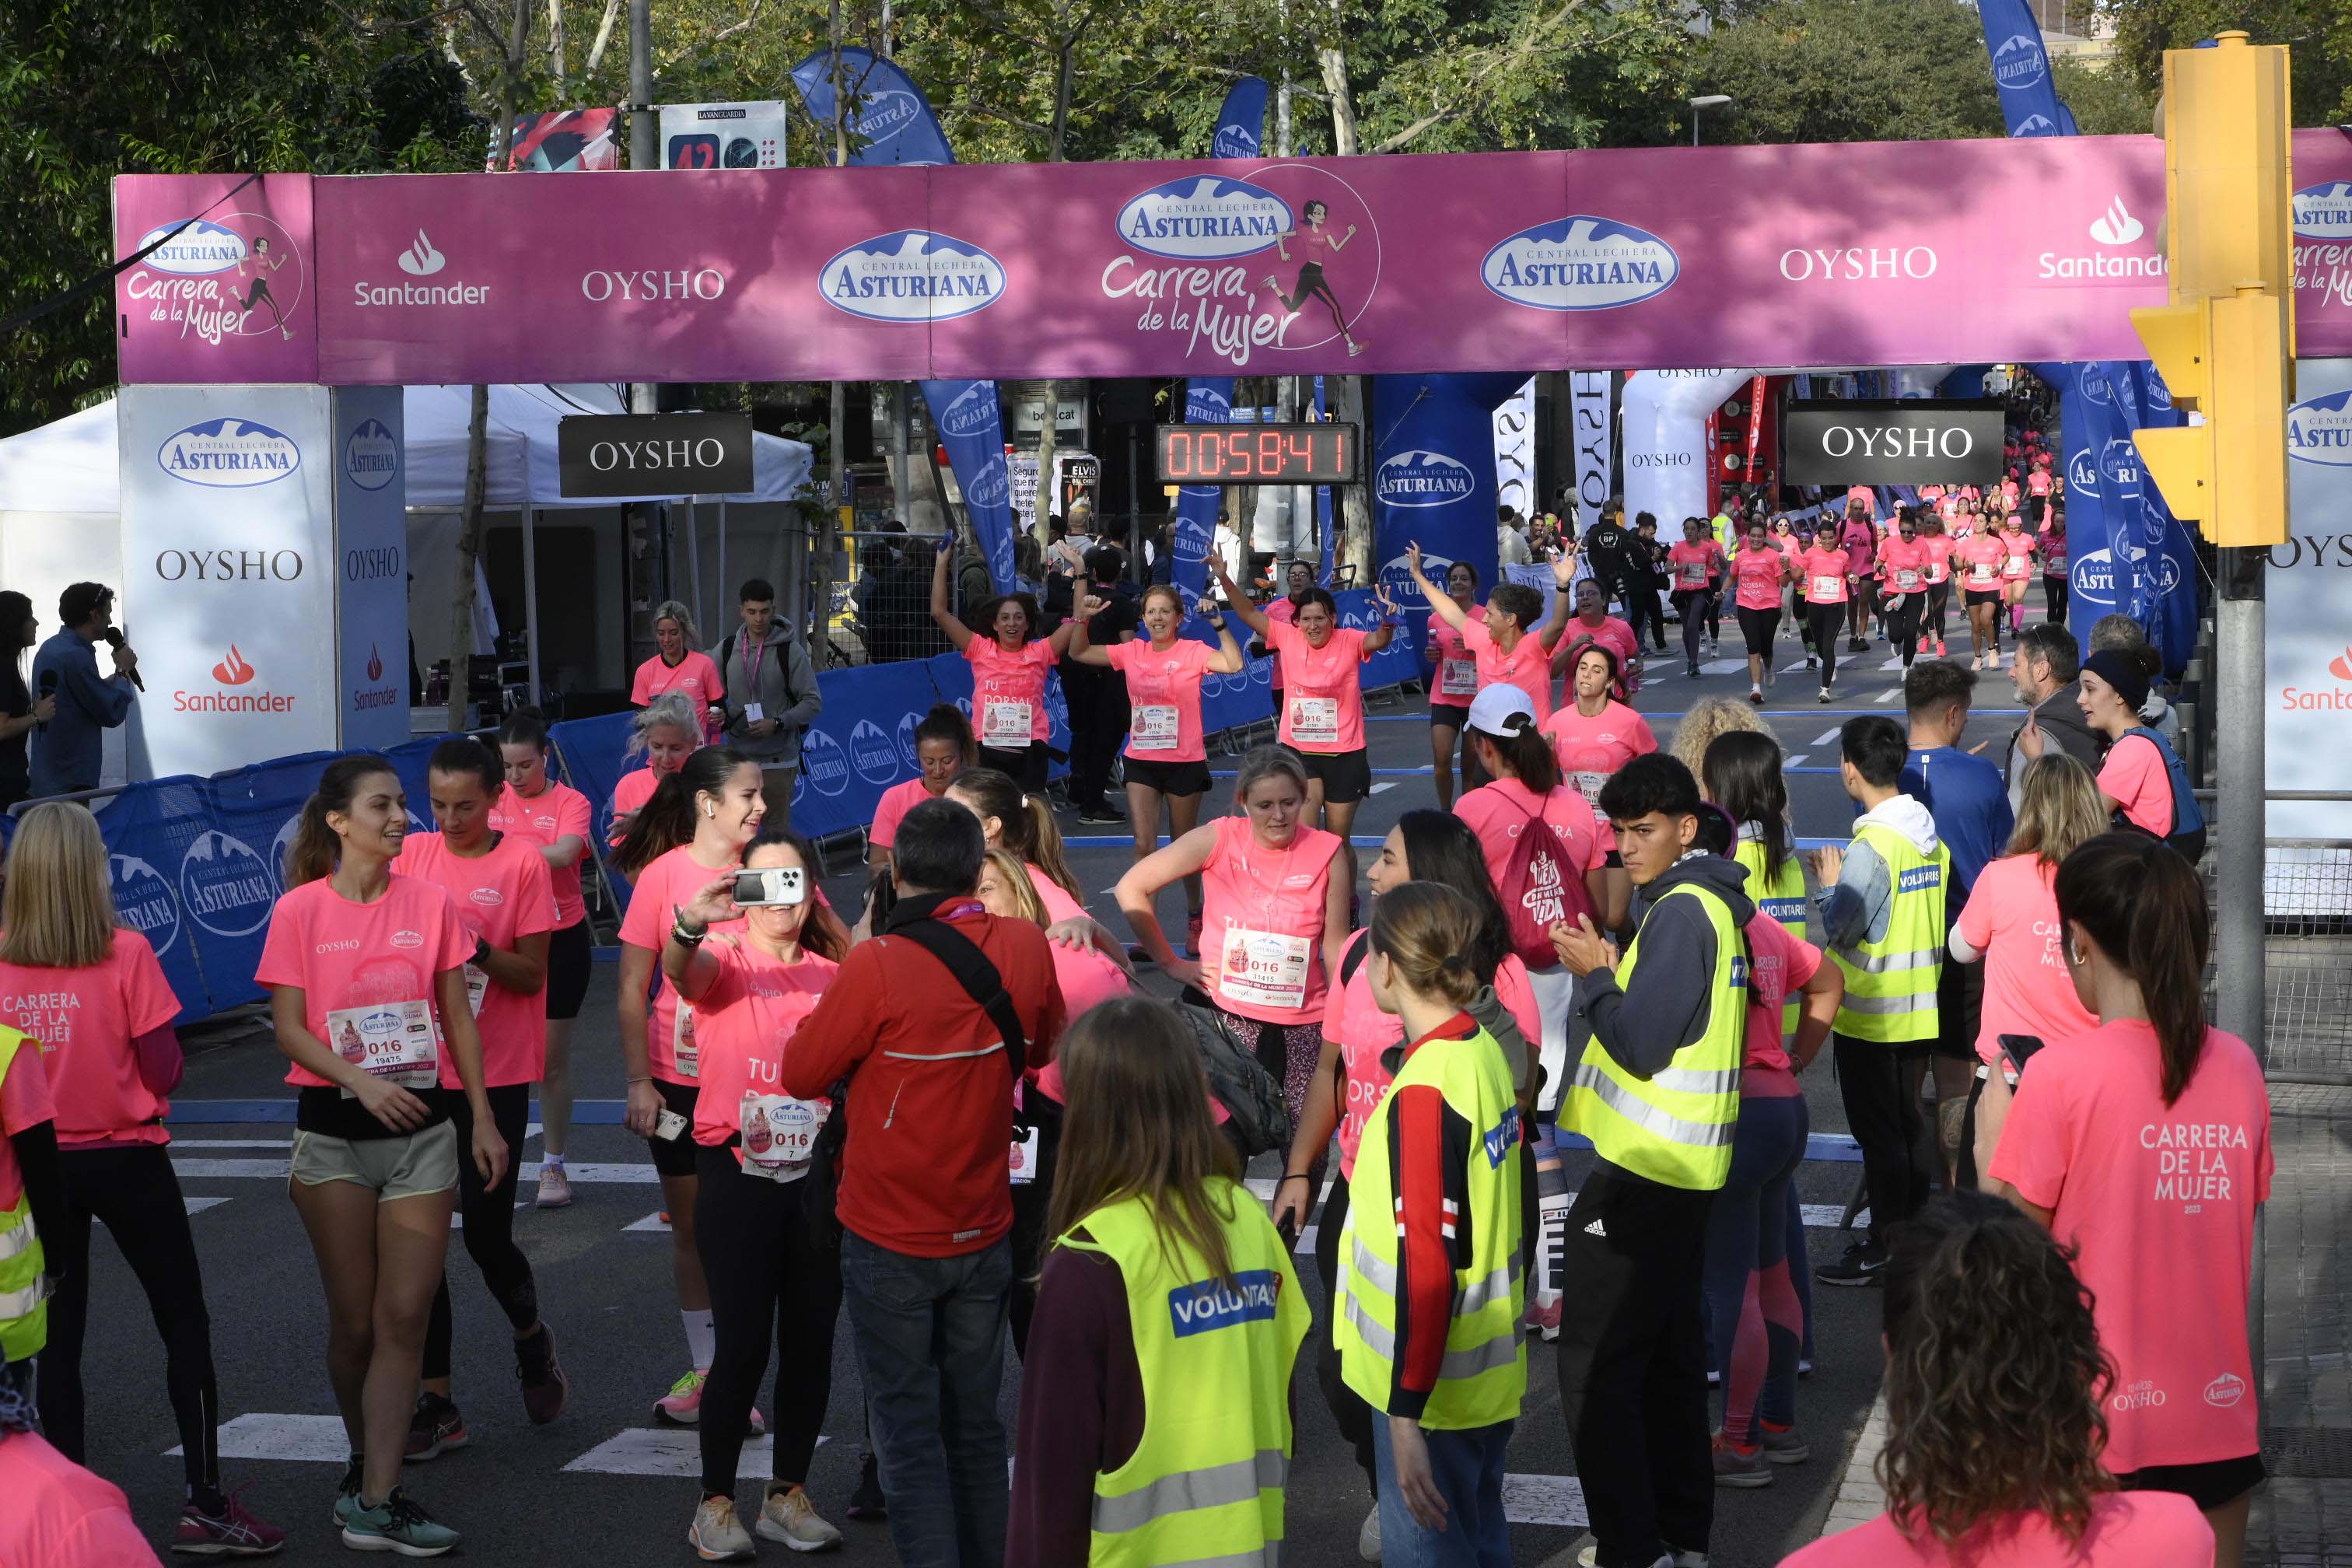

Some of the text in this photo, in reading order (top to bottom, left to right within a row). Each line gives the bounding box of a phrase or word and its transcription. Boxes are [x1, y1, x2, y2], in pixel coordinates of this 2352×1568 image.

[1157, 202, 1275, 213] CENTRAL LECHERA
[1130, 207, 1280, 239] ASTURIANA
[145, 239, 239, 261] ASTURIANA
[1527, 247, 1657, 259] CENTRAL LECHERA
[862, 261, 985, 271] CENTRAL LECHERA
[1496, 251, 1664, 287] ASTURIANA
[1779, 246, 1938, 281] OYSHO
[2039, 252, 2169, 278] Santand
[127, 271, 219, 300] Carrera
[582, 269, 725, 302] OYSHO
[833, 264, 992, 298] ASTURIANA
[1101, 255, 1248, 299] Carrera
[2311, 267, 2325, 289] la
[355, 281, 490, 306] Santander
[150, 297, 254, 345] de la Mujer
[1137, 294, 1302, 366] de la Mujer
[1186, 404, 1228, 423] STURIANA
[1821, 426, 1973, 459] OYSHO
[169, 443, 292, 471] ASTURIANA
[349, 446, 395, 474] ASTURIANA
[590, 437, 726, 472] OYSHO
[1632, 452, 1692, 468] OYSHO
[1072, 465, 1096, 476] ELVIS
[1013, 479, 1027, 488] que
[1379, 472, 1468, 495] ASTURIANA
[1018, 509, 1030, 519] ste
[1174, 537, 1210, 555] URIANA
[2267, 534, 2352, 569] OYS
[156, 549, 303, 582] OYSHO
[347, 545, 400, 582] OYSHO
[984, 680, 999, 691] TU
[173, 691, 296, 713] Santander
[353, 683, 398, 712] Santander
[1132, 695, 1143, 706] TU
[2282, 688, 2352, 711] Santa
[807, 756, 847, 782] ASTURIANA
[853, 746, 898, 772] ASTURIANA
[190, 873, 271, 916] ASTURIANA
[316, 939, 360, 955] OYSHO
[1251, 961, 1279, 973] 016
[1252, 973, 1275, 983] 31415
[750, 982, 782, 999] OSHO
[3, 992, 82, 1013] CARRERA
[19, 1010, 69, 1027] DE LA
[362, 1020, 400, 1031] ASTURIANA
[368, 1039, 403, 1055] 016
[374, 1055, 402, 1066] 19475
[748, 1057, 779, 1083] TU
[1349, 1078, 1391, 1107] ORS
[773, 1111, 812, 1122] ASTURIANA
[775, 1132, 810, 1146] 016
[2140, 1124, 2248, 1150] CARRERA
[2160, 1150, 2228, 1174] DE LA
[2154, 1175, 2231, 1202] MUJER
[1542, 1211, 1569, 1220] FIL
[2183, 1205, 2201, 1214] 2023
[1584, 1226, 1607, 1237] adidas
